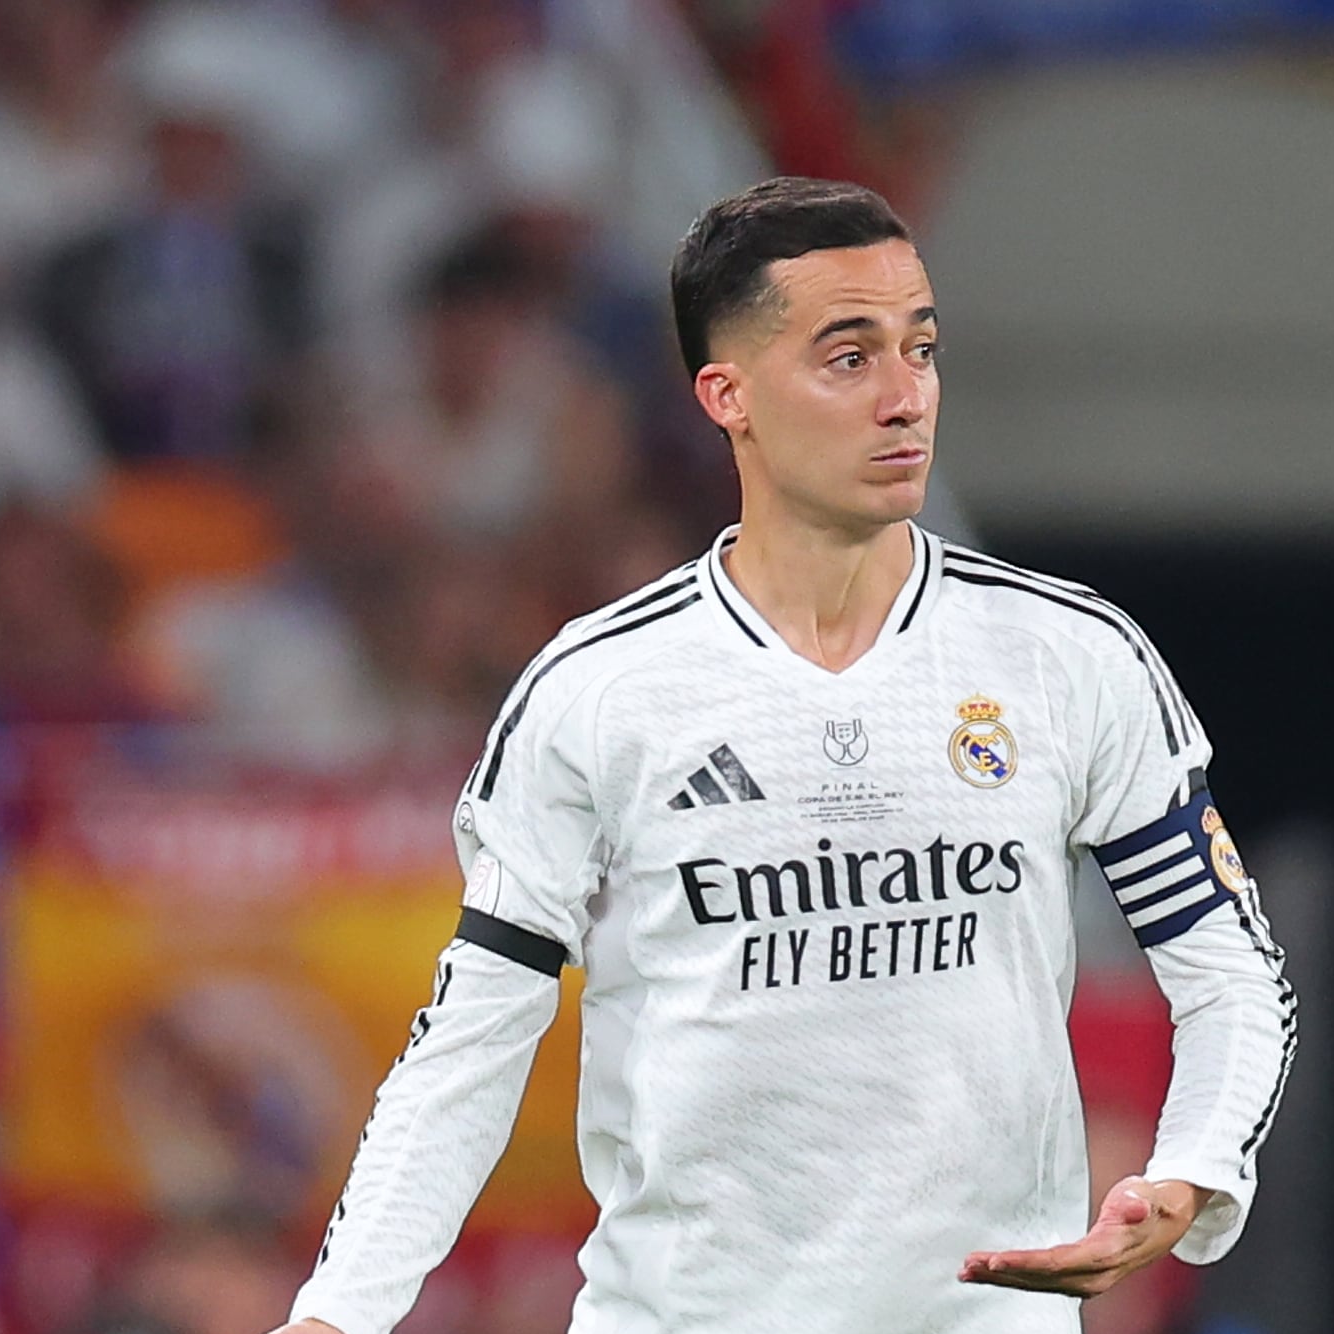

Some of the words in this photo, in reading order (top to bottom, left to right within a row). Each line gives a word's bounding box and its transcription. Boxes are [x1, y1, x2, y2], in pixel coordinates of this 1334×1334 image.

[677, 833, 1025, 925] Emirates
[741, 928, 810, 991] FLY
[829, 911, 978, 982] BETTER
